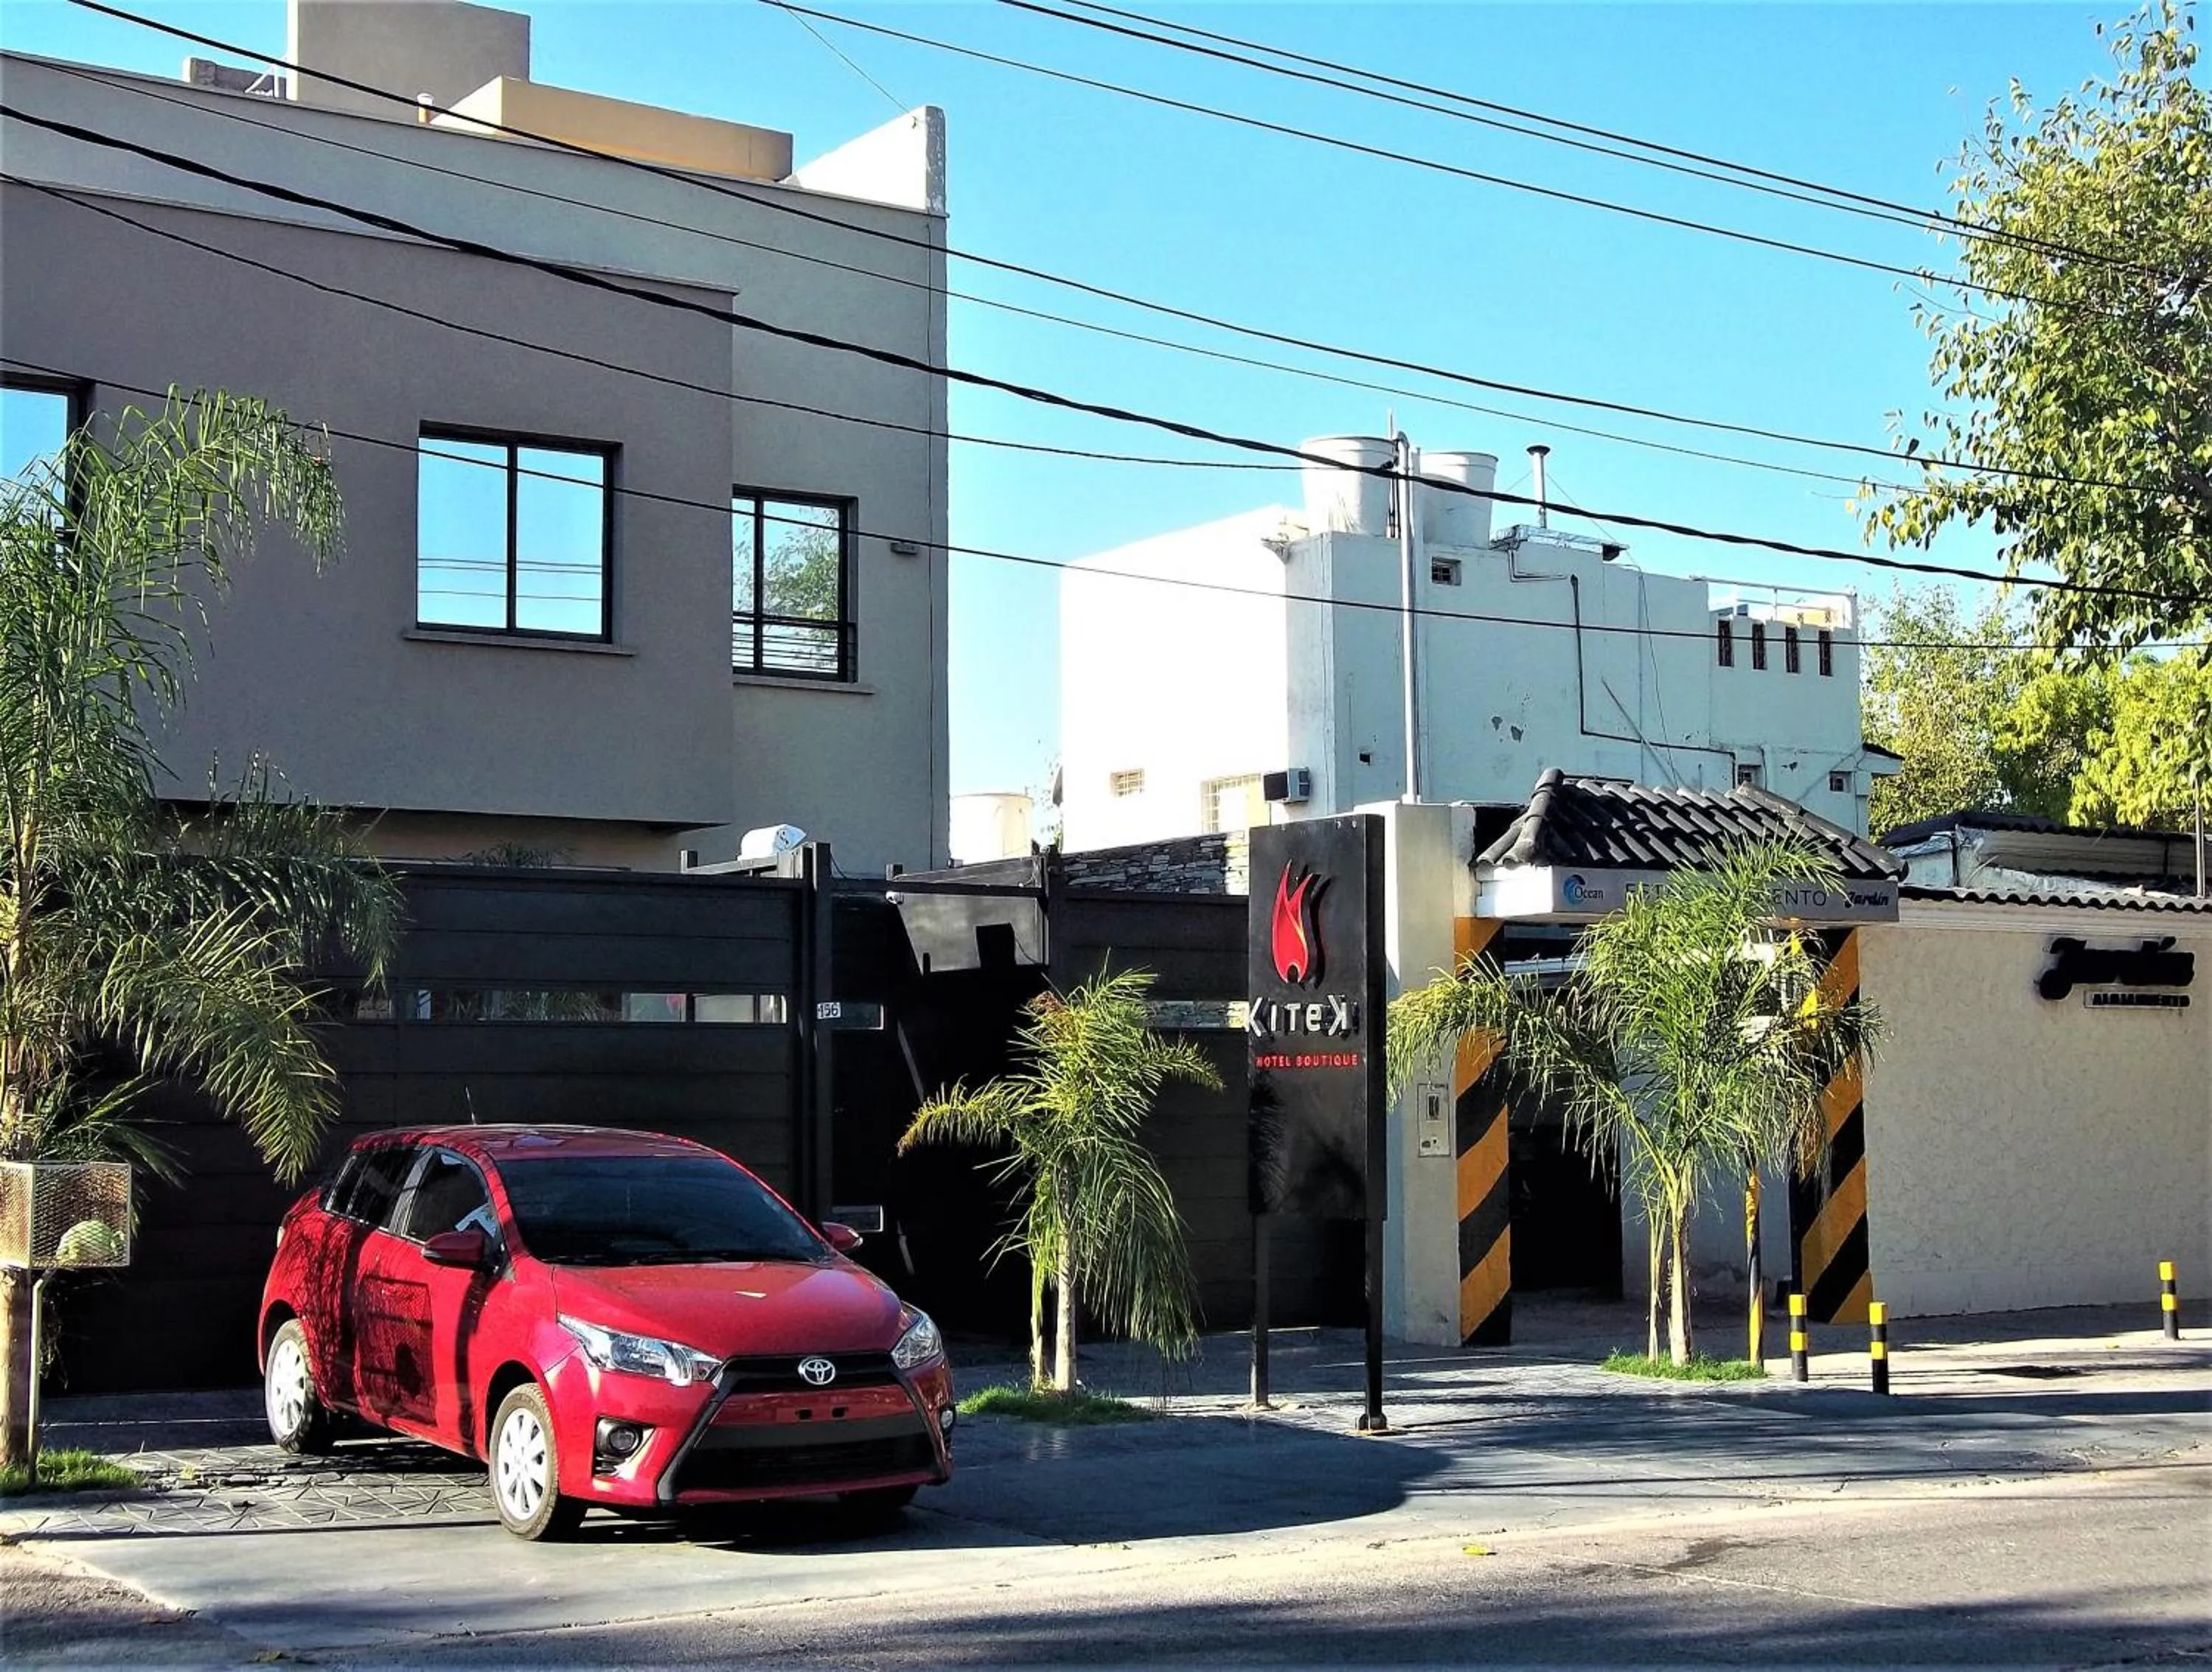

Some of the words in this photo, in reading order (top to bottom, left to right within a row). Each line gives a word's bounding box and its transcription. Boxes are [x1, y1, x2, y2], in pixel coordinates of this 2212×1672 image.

[1574, 885, 1604, 899] Ocean
[1256, 1054, 1290, 1067] HOTEL
[1296, 1053, 1358, 1067] BOUTIQUE
